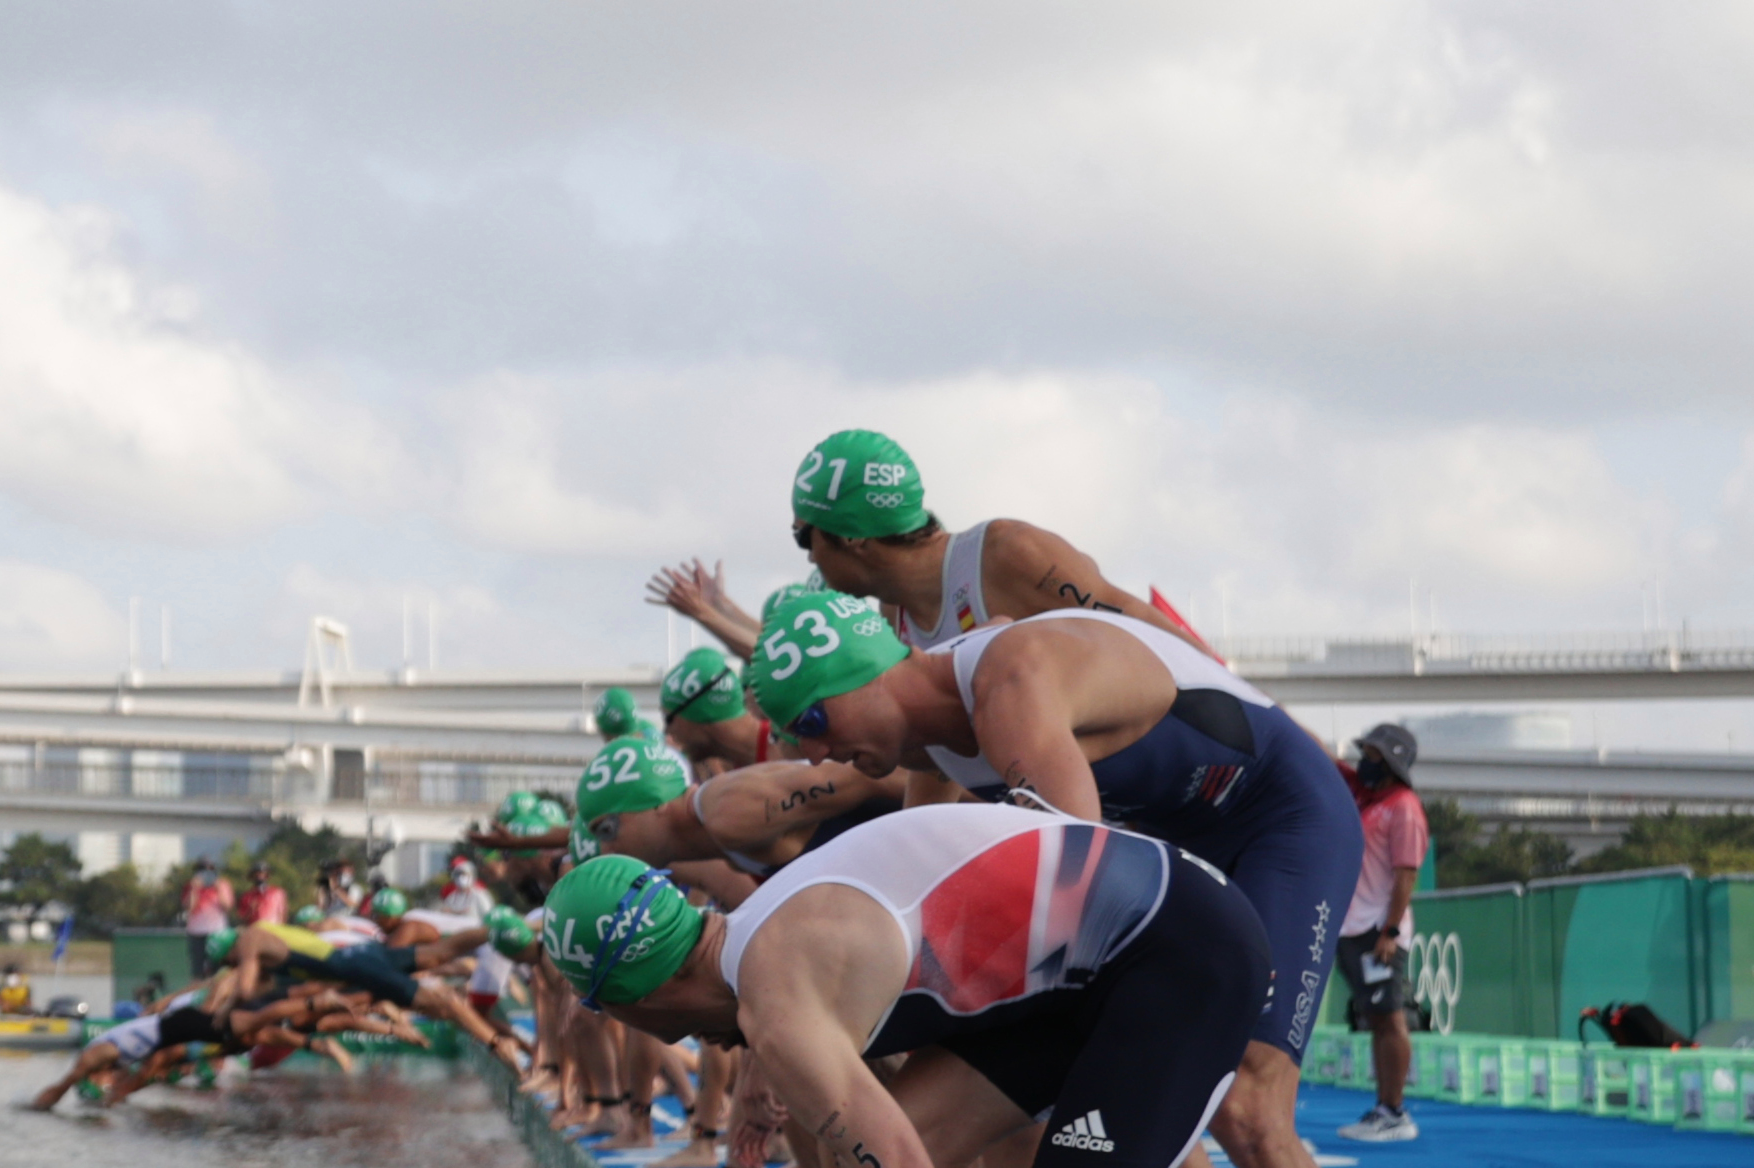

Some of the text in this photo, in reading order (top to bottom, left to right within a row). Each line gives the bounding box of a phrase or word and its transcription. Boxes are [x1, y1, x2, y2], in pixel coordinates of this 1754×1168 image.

[796, 451, 848, 500] 21
[863, 462, 906, 486] ESP
[763, 610, 841, 681] 53
[666, 668, 701, 699] 46
[586, 748, 641, 791] 52
[781, 781, 836, 811] 52
[544, 907, 595, 969] 54
[1287, 970, 1320, 1050] USA
[1051, 1131, 1115, 1153] adidas
